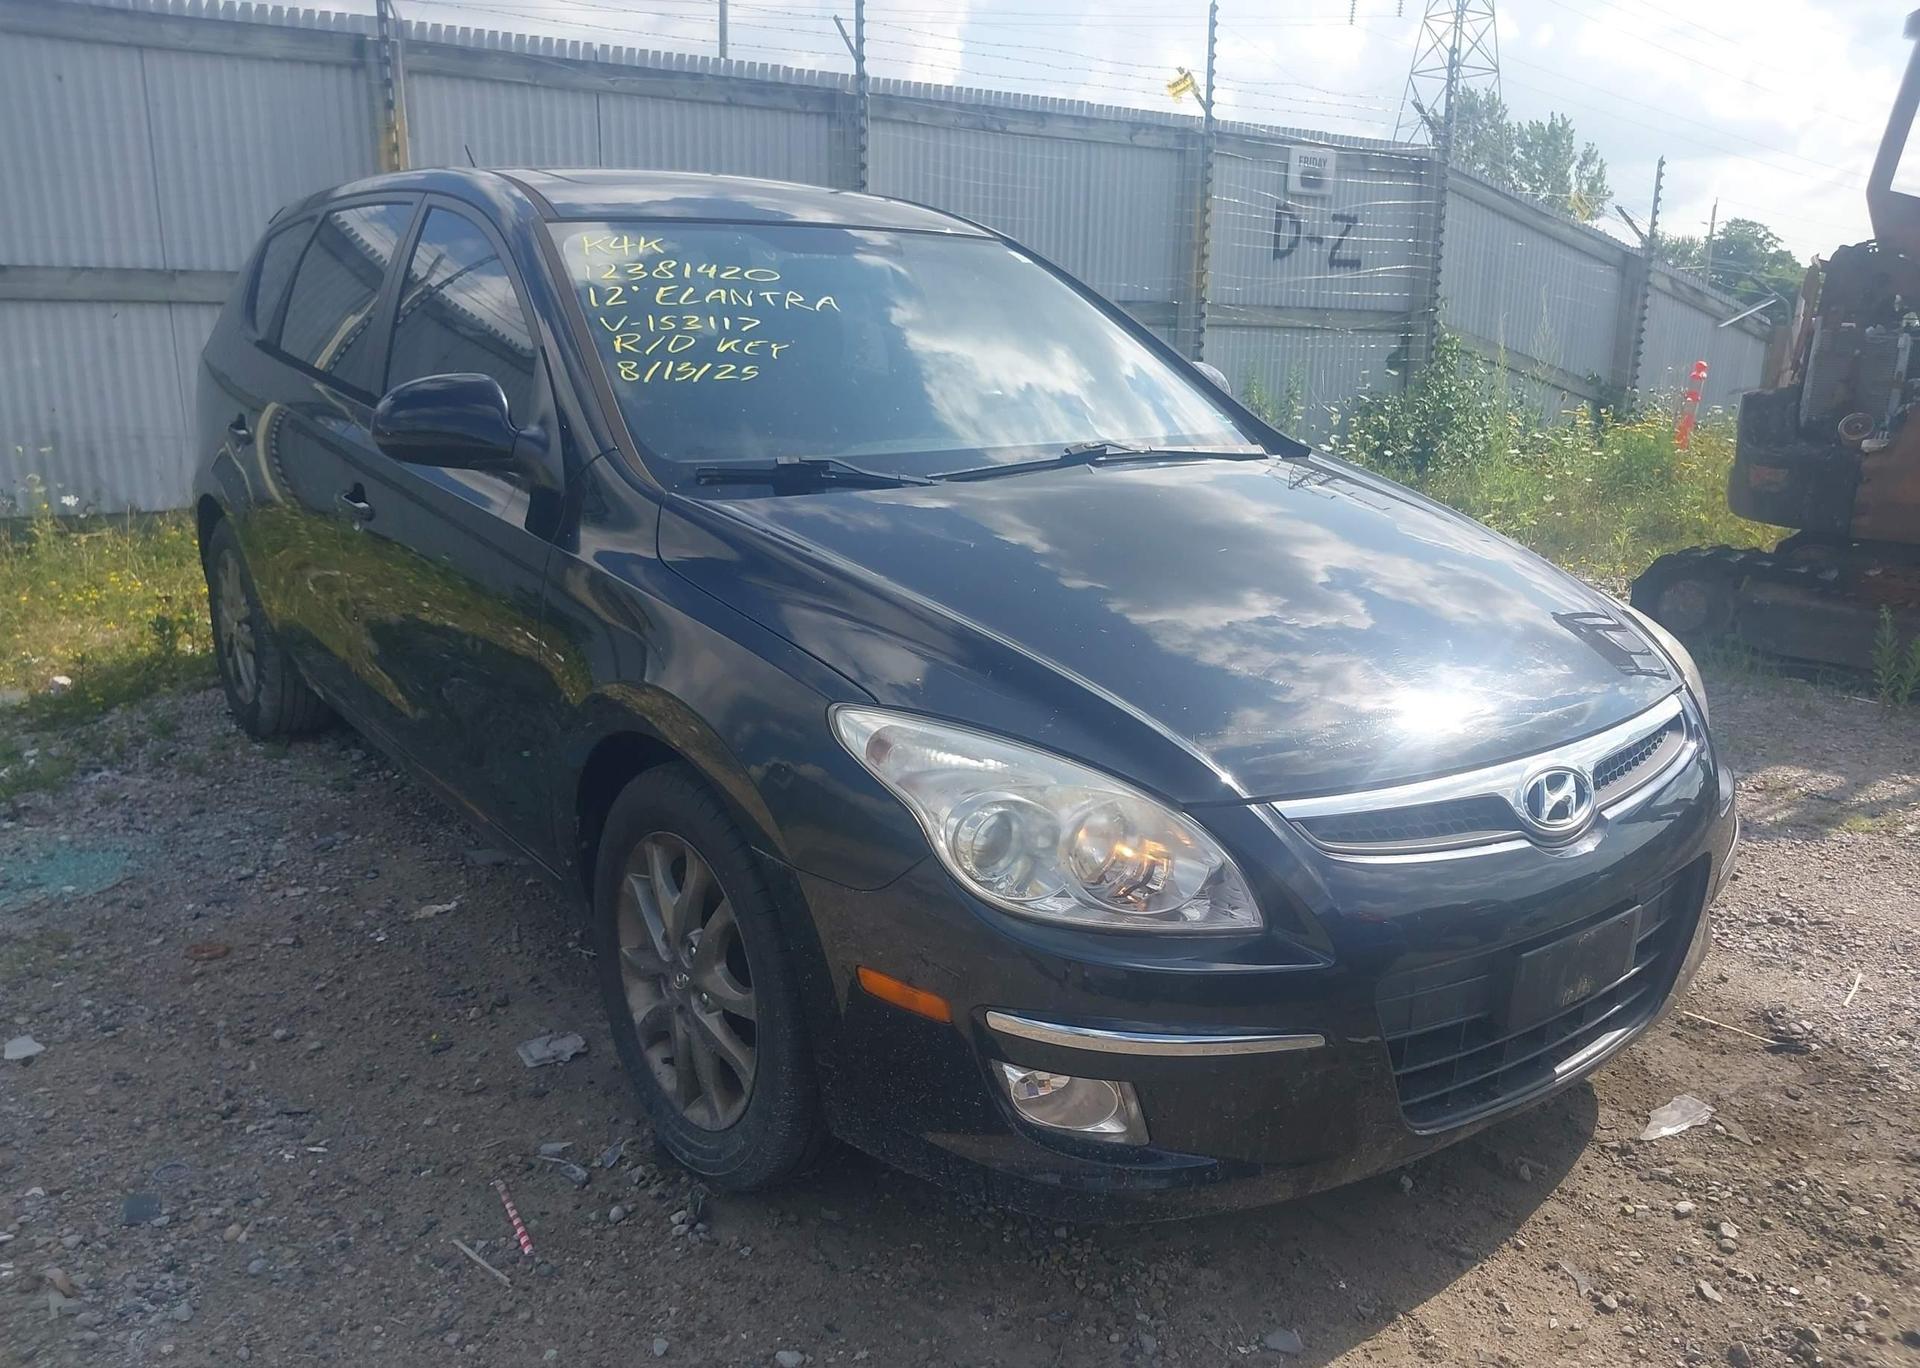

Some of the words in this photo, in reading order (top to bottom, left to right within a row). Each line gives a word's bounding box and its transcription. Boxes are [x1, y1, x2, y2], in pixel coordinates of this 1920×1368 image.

[1298, 155, 1328, 169] FRIDAY
[584, 235, 664, 257] K4K
[585, 260, 781, 282] 12381420
[655, 284, 841, 313] ELANTRA
[599, 313, 761, 332] V-153117
[716, 336, 790, 360] KEY
[616, 360, 760, 383] 8/13/25
